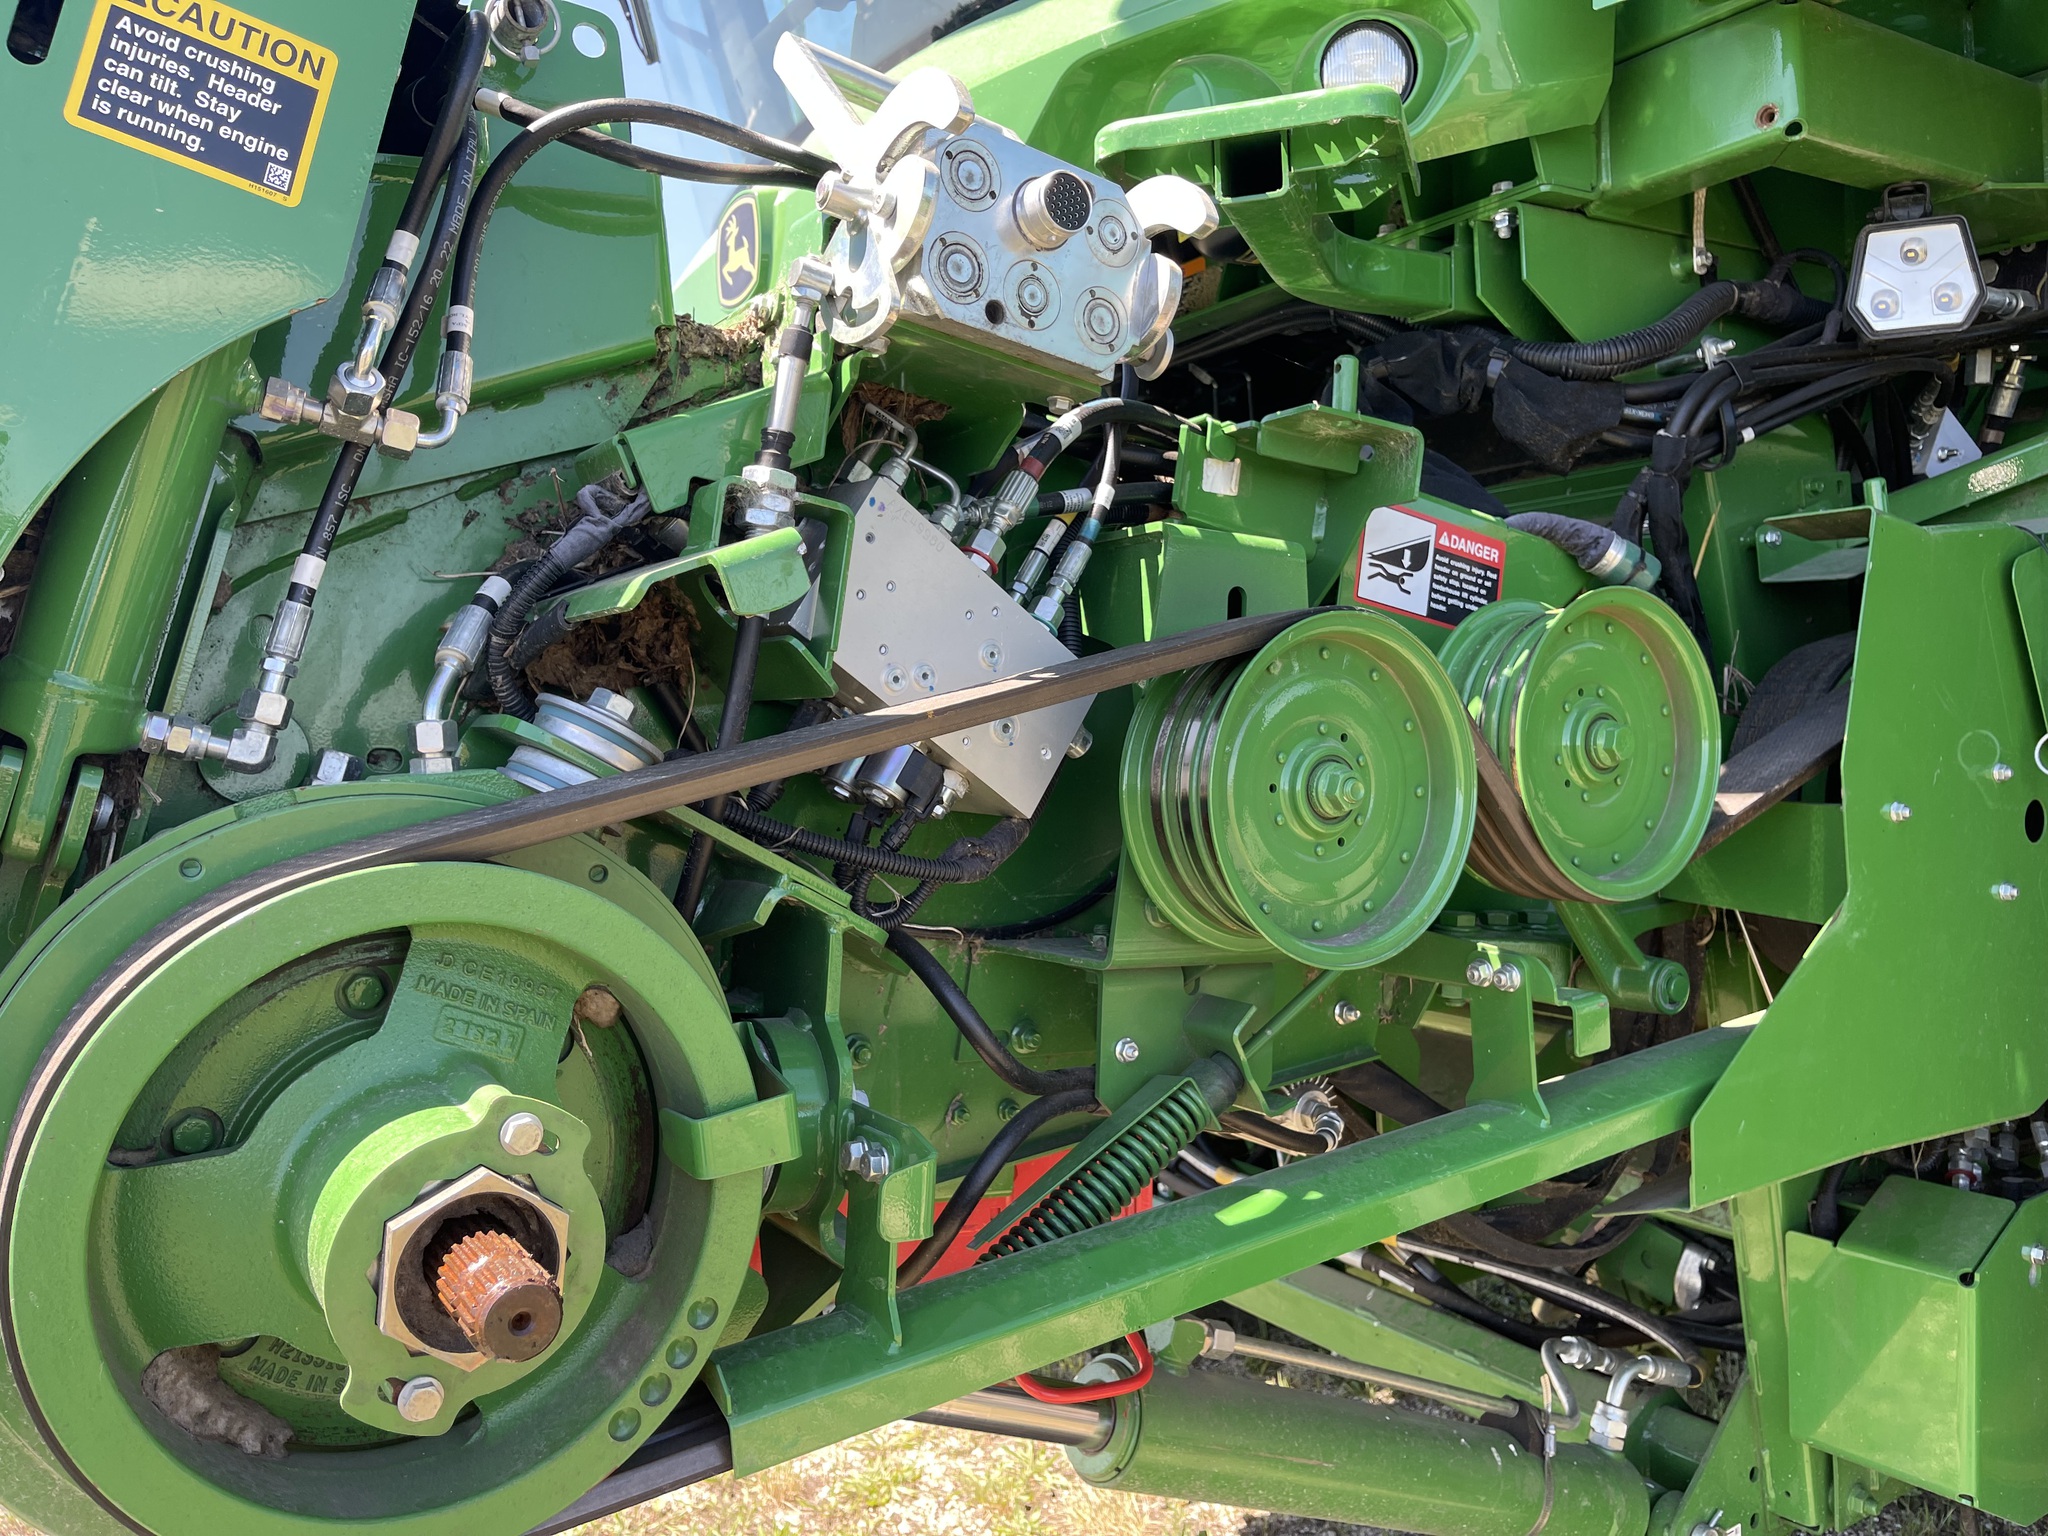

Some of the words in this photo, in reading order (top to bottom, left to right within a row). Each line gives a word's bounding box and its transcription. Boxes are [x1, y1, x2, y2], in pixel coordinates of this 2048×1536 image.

[115, 15, 180, 53] Avoid
[184, 44, 276, 95] crushing
[152, 0, 326, 81] CAUTION
[103, 57, 143, 83] can
[150, 72, 182, 98] tilt.
[194, 90, 241, 123] Stay
[109, 34, 195, 82] injuries.
[208, 73, 282, 115] Header
[91, 94, 111, 115] is
[116, 106, 205, 153] running.
[97, 77, 152, 108] clear
[158, 99, 213, 133] when
[219, 124, 289, 162] engine
[466, 128, 478, 163] ITALY
[461, 170, 473, 189] IN
[488, 170, 515, 216] exceeds
[448, 195, 467, 235] MADE
[441, 241, 455, 262] 22
[394, 294, 434, 369] IC-152/16
[323, 514, 338, 541] 857
[334, 483, 351, 508] 1SC
[1434, 563, 1451, 574] header
[1460, 572, 1476, 583] ground
[1435, 554, 1449, 563] Avoid
[1450, 560, 1471, 572] crushing
[1450, 534, 1499, 564] DANGER
[415, 974, 475, 1006] MADE
[478, 993, 500, 1013] IN
[502, 1001, 557, 1032] SPAIN
[247, 1356, 302, 1389] MADE
[305, 1373, 329, 1394] IN
